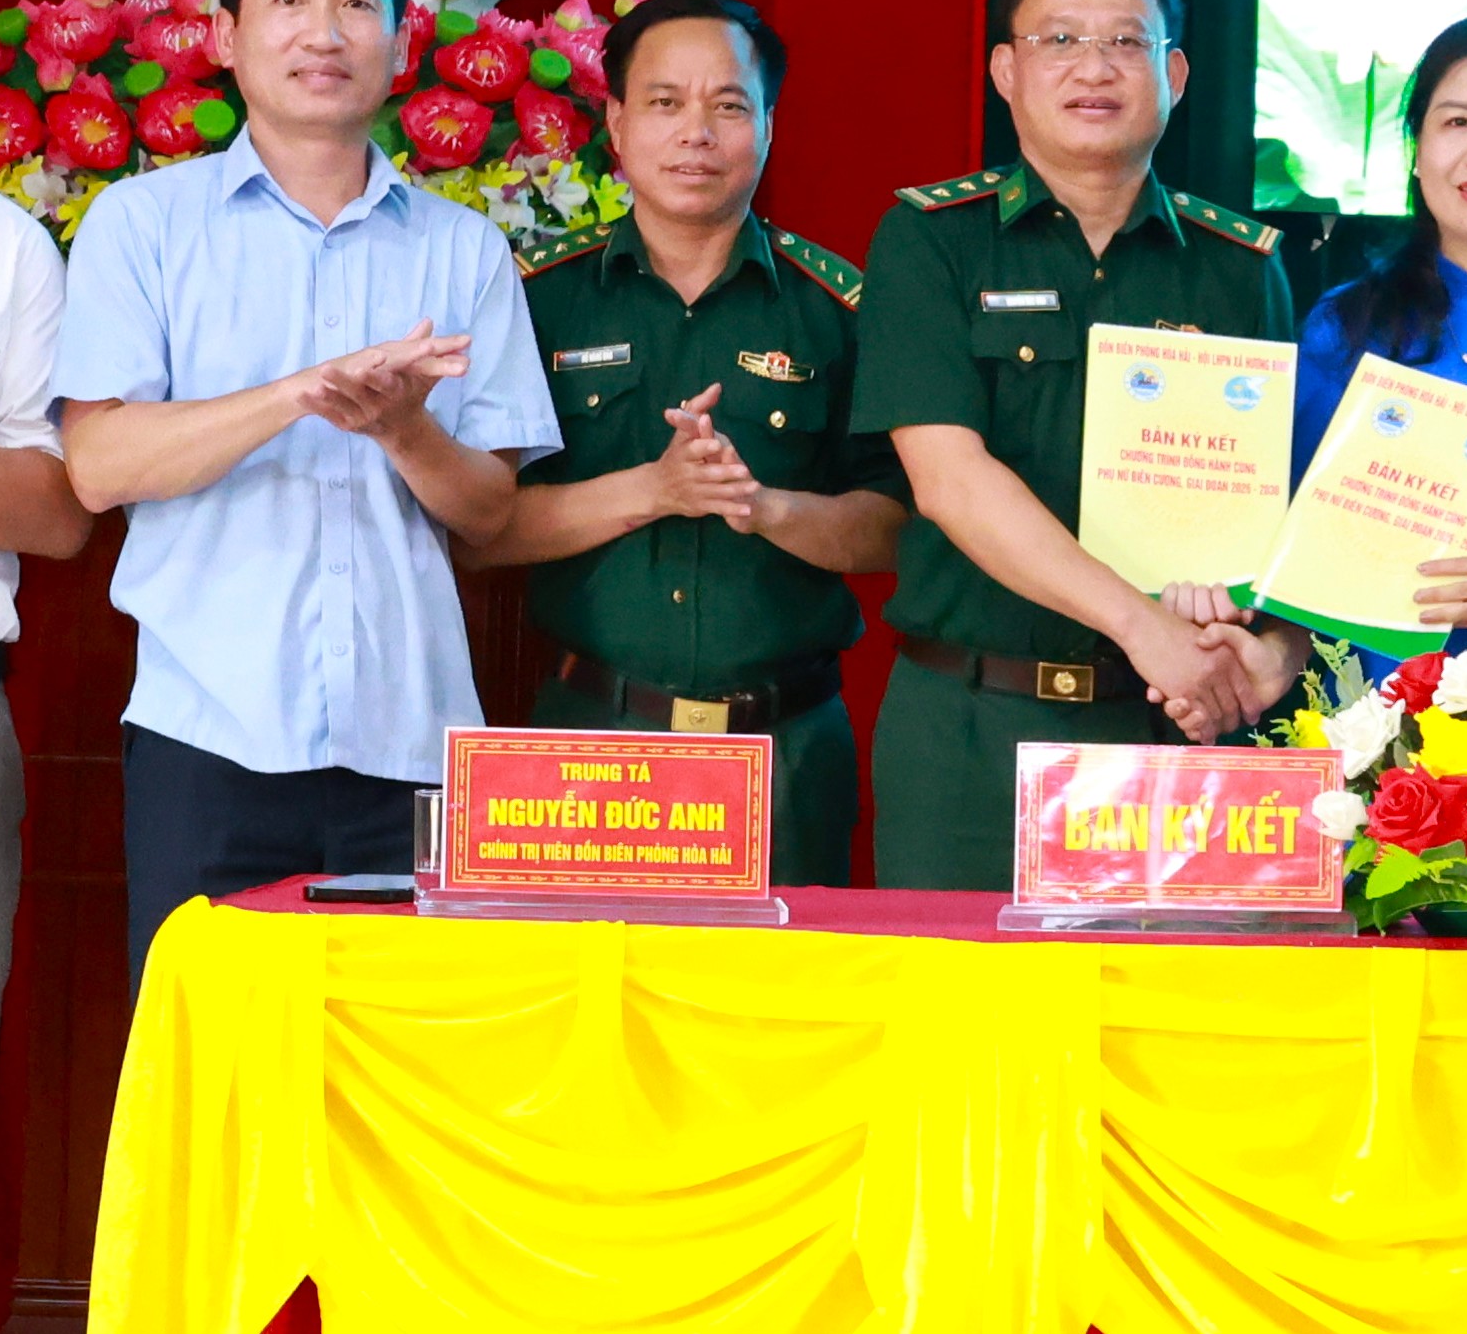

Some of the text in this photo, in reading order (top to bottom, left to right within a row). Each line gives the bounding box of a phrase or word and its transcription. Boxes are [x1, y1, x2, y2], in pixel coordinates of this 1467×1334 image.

[1207, 433, 1238, 453] KẾT
[559, 761, 652, 783] TRUNG TÁ
[488, 789, 726, 832] NGUYỄN ĐỨC ANH
[1226, 790, 1302, 855] KẾT
[478, 838, 518, 860] CHÍNH
[520, 842, 540, 865] TRỊ
[542, 840, 572, 861] VIÊN
